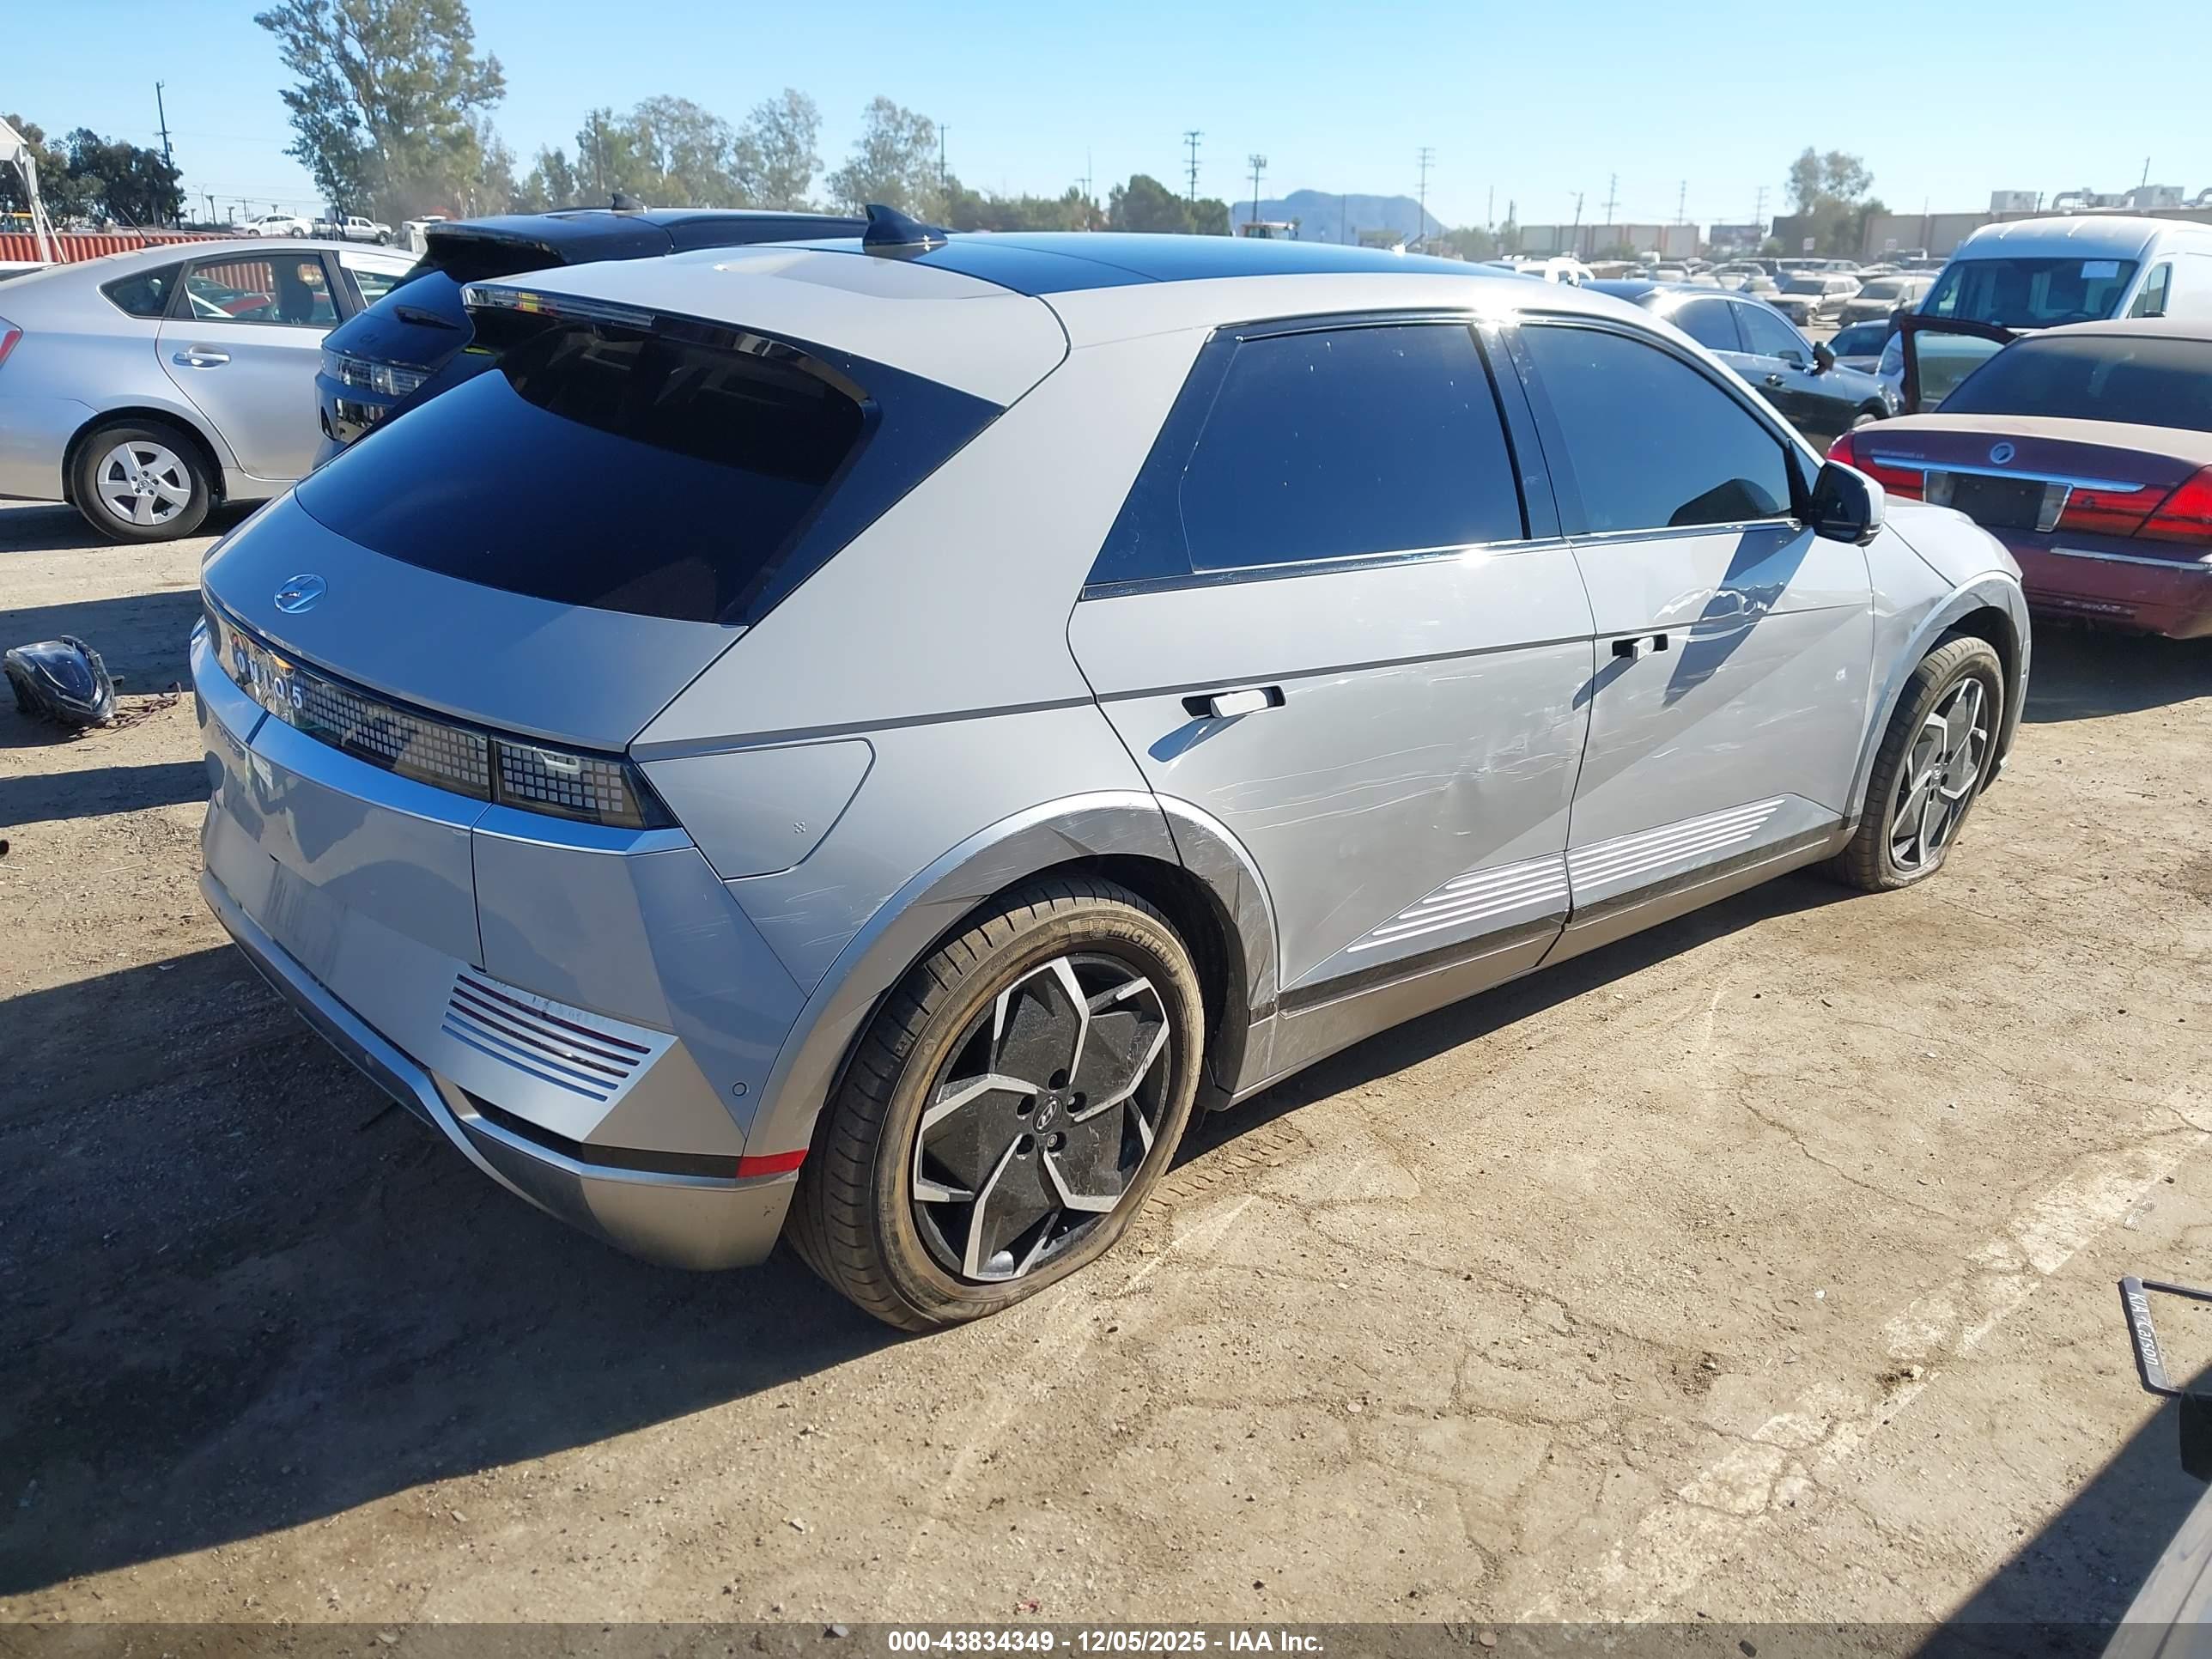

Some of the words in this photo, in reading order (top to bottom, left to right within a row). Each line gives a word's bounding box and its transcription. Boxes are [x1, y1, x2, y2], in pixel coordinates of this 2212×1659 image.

[234, 650, 286, 700] ONIQ
[292, 685, 303, 709] 5
[1110, 921, 1180, 974] MICHELIN
[2128, 1291, 2150, 1313] KIA
[2136, 1322, 2159, 1366] Carson
